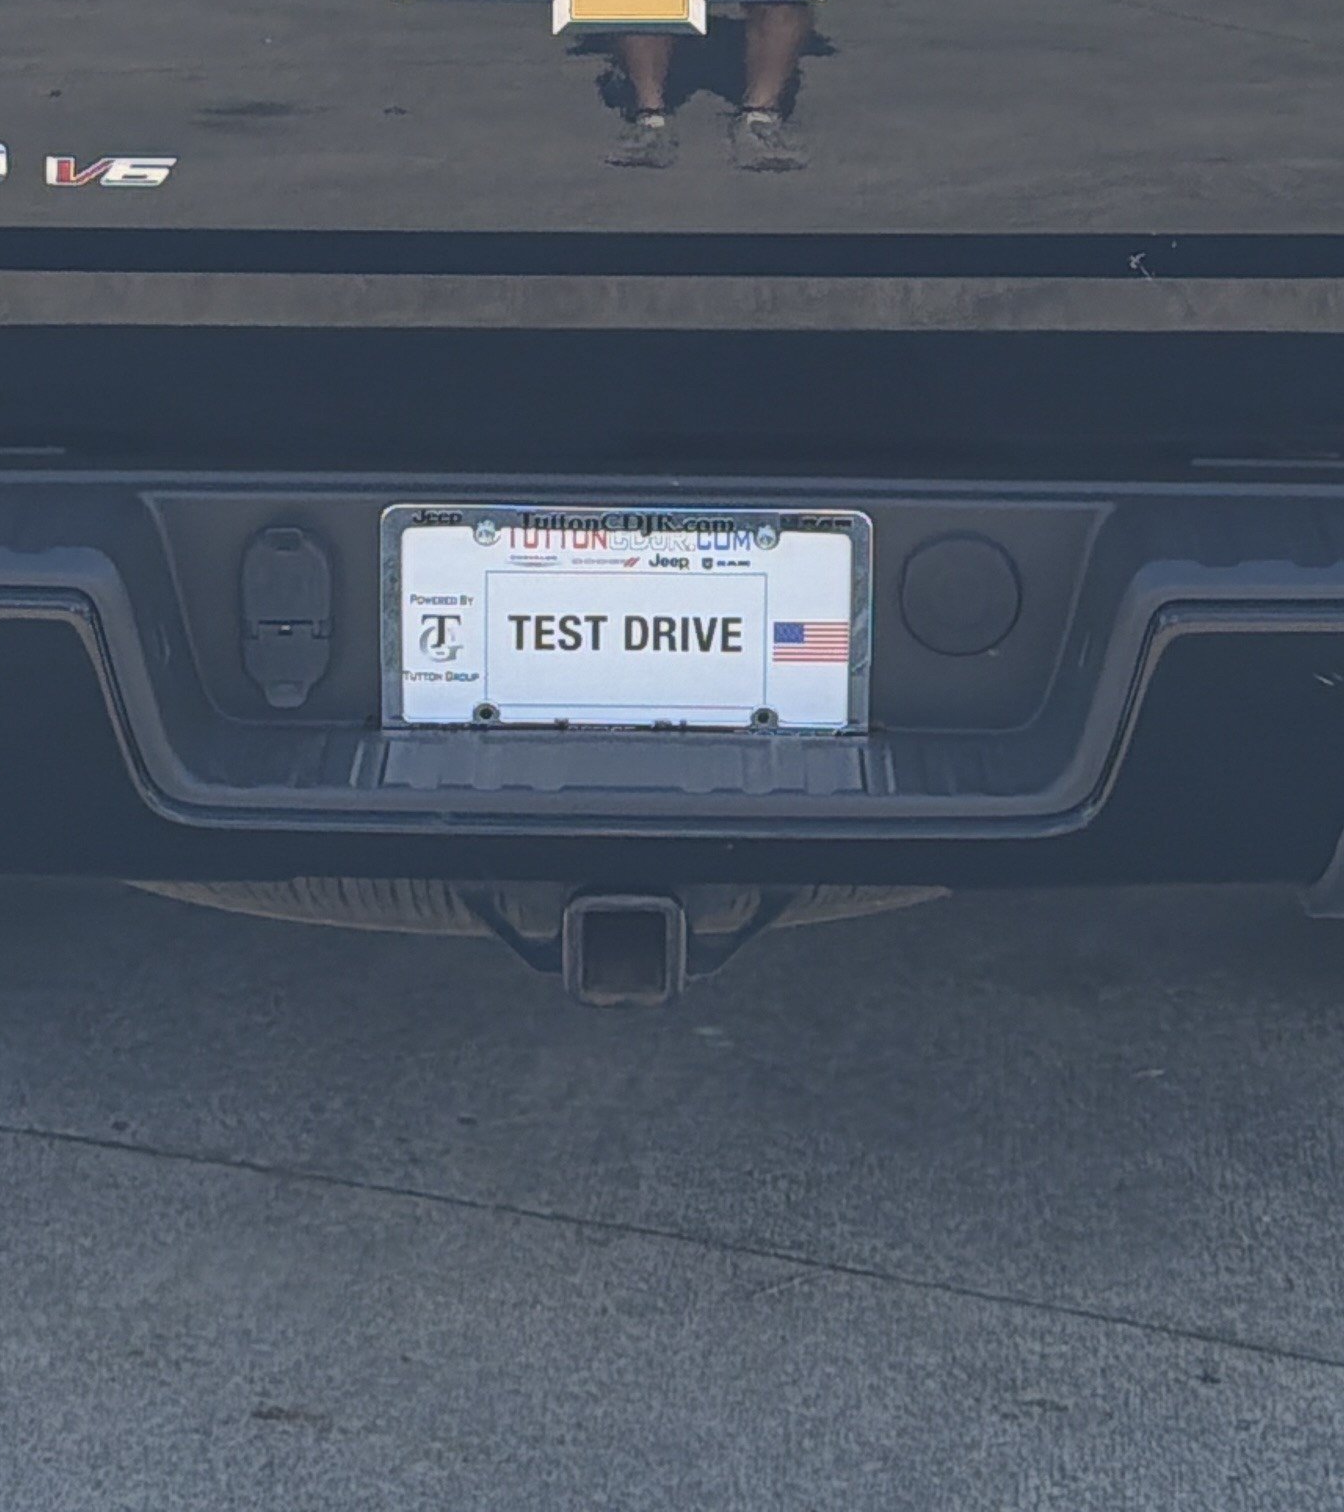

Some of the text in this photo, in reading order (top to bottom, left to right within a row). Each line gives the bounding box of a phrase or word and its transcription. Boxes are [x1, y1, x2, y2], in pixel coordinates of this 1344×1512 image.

[45, 155, 179, 187] V6
[412, 508, 463, 525] Jeep
[648, 552, 690, 571] Jeep
[507, 614, 743, 653] TEST DRIVE
